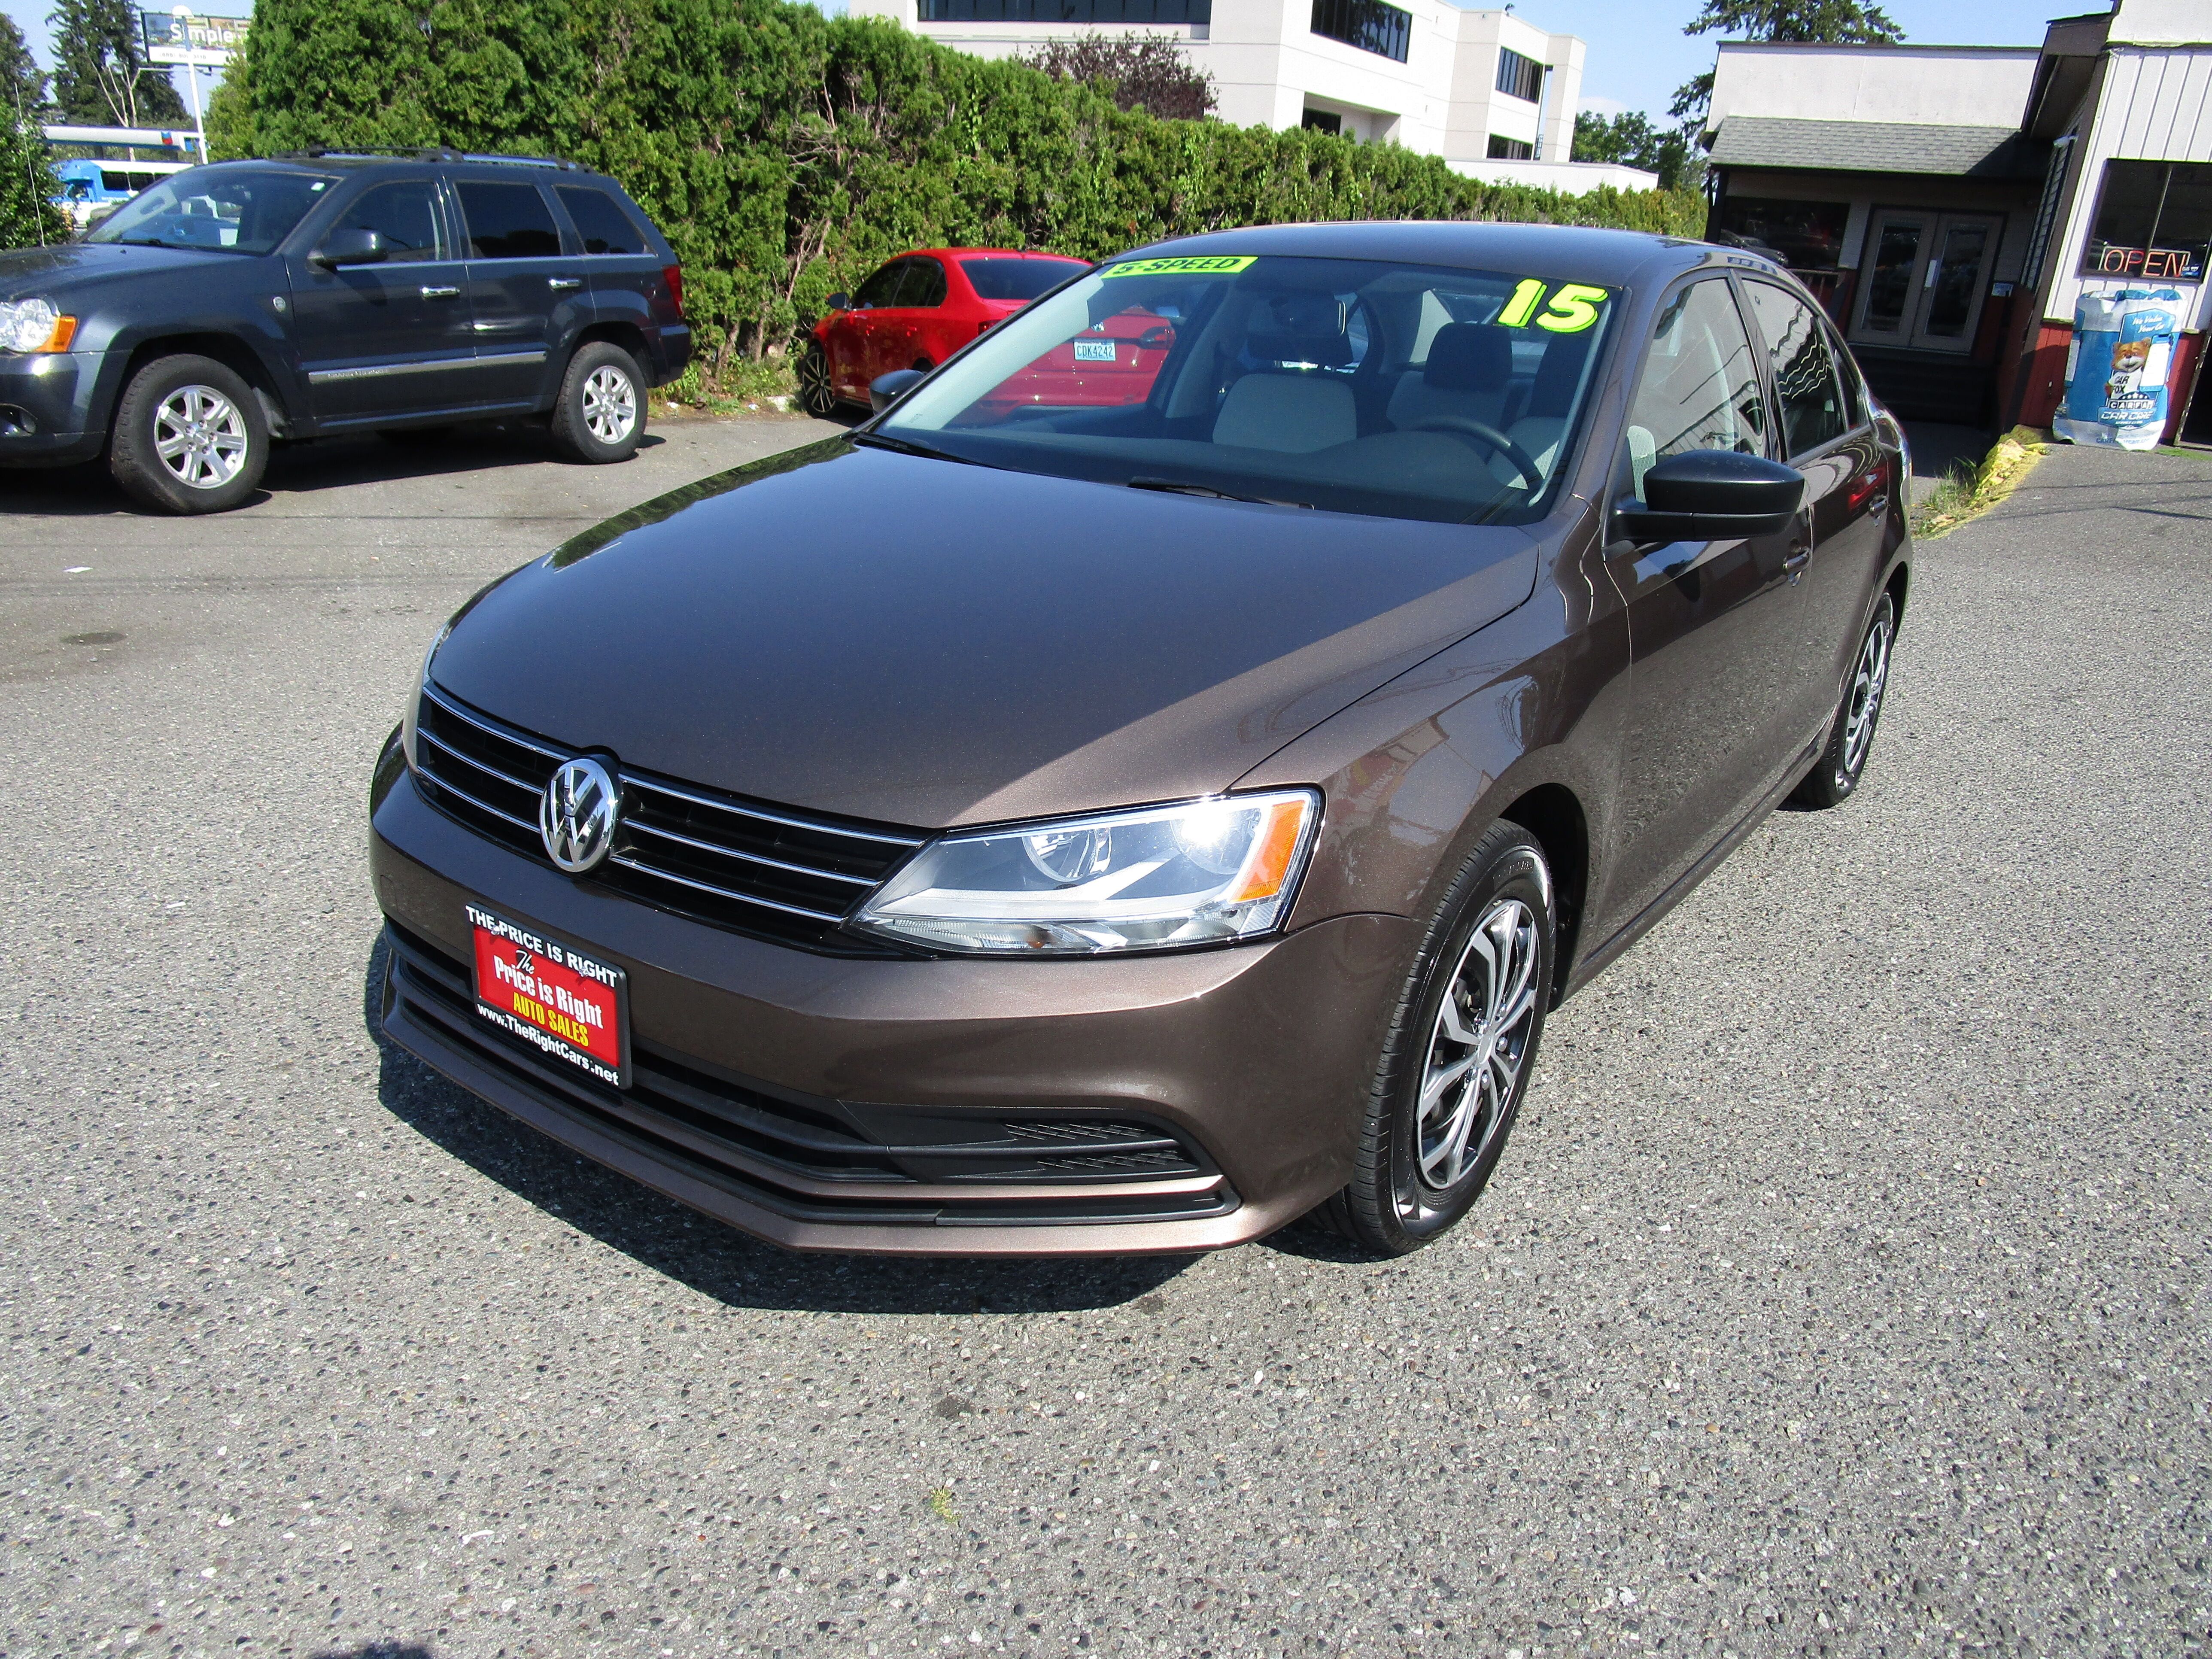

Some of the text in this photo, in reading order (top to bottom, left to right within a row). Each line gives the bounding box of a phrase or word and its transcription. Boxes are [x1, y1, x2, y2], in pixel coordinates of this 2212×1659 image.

[1112, 258, 1241, 274] 5-SPEED
[2104, 249, 2186, 277] OPEN
[1497, 278, 1609, 333] 15
[1077, 345, 1113, 357] CDK4242
[2114, 375, 2130, 384] CAR
[2101, 410, 2154, 419] CAR CARE
[465, 905, 617, 988] THE PRICE IS RIGHT
[515, 949, 535, 974] The
[493, 955, 603, 1029] Price is Right
[513, 992, 589, 1047] AUTO SALES
[477, 1003, 619, 1086] www.TheRightCars.net
